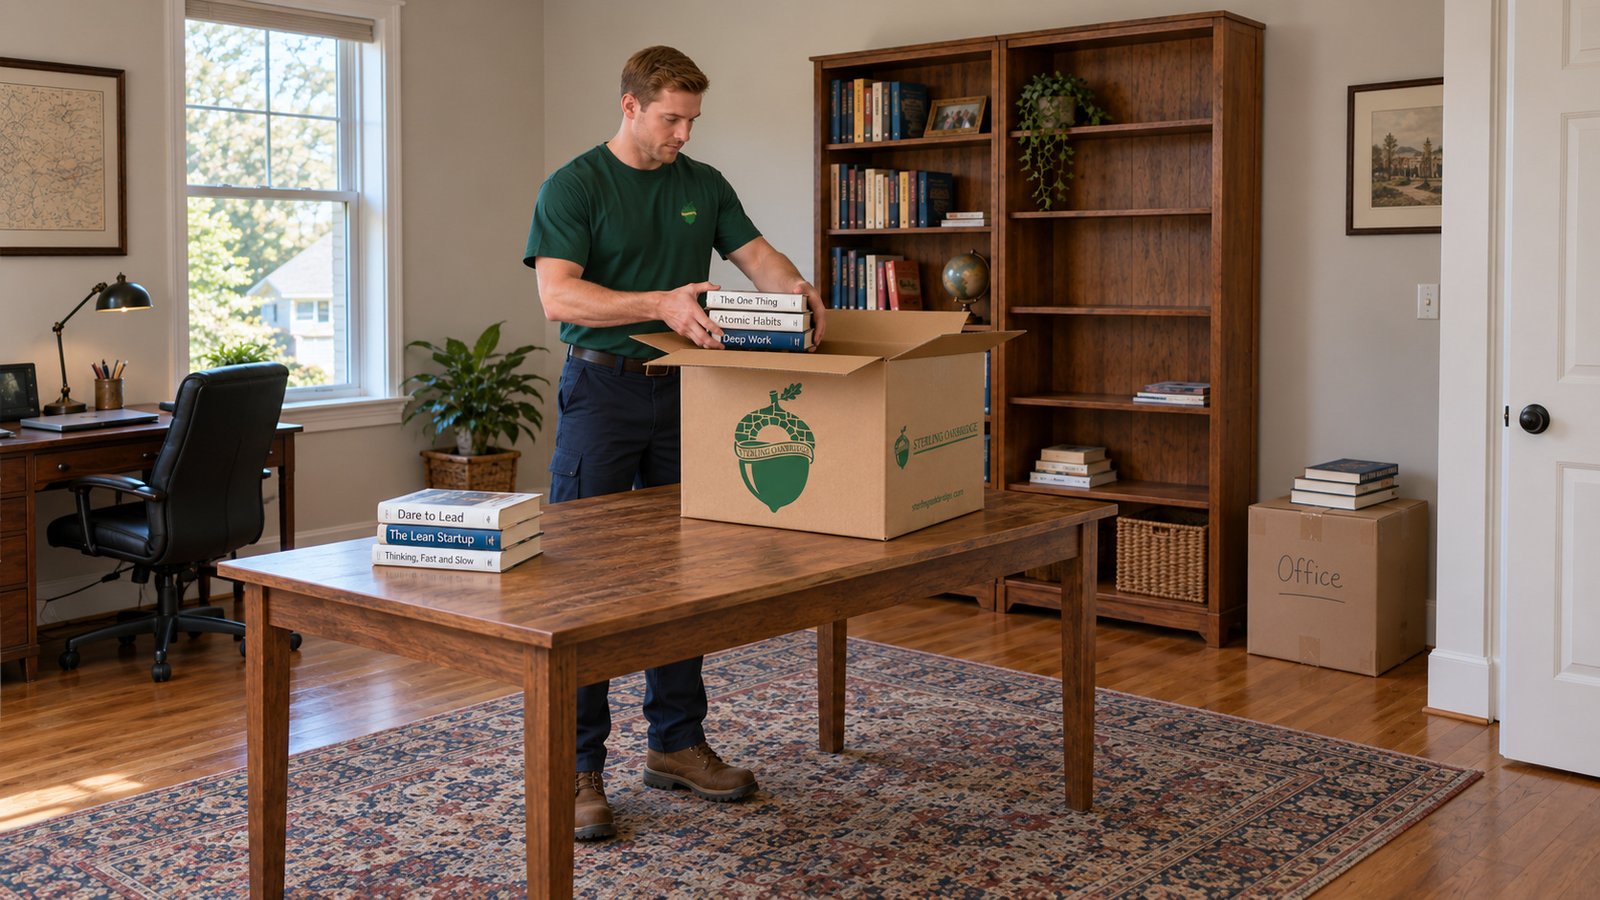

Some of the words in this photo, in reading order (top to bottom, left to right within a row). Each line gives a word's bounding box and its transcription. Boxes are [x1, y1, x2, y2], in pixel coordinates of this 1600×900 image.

[720, 296, 735, 304] The
[737, 296, 753, 304] One
[755, 297, 778, 307] Thing
[718, 315, 750, 325] Atomic
[753, 316, 782, 326] Habits
[723, 334, 746, 346] Deep
[748, 335, 772, 345] Work
[398, 509, 421, 520] Dare
[425, 511, 436, 520] to
[439, 511, 464, 523] Lead
[389, 529, 408, 540] The
[410, 531, 435, 542] Lean
[437, 532, 475, 547] Startup
[385, 551, 419, 563] Thinking,
[420, 554, 437, 563] Fast
[438, 556, 453, 564] and
[455, 556, 474, 565] Slow
[1278, 555, 1343, 588] Office
